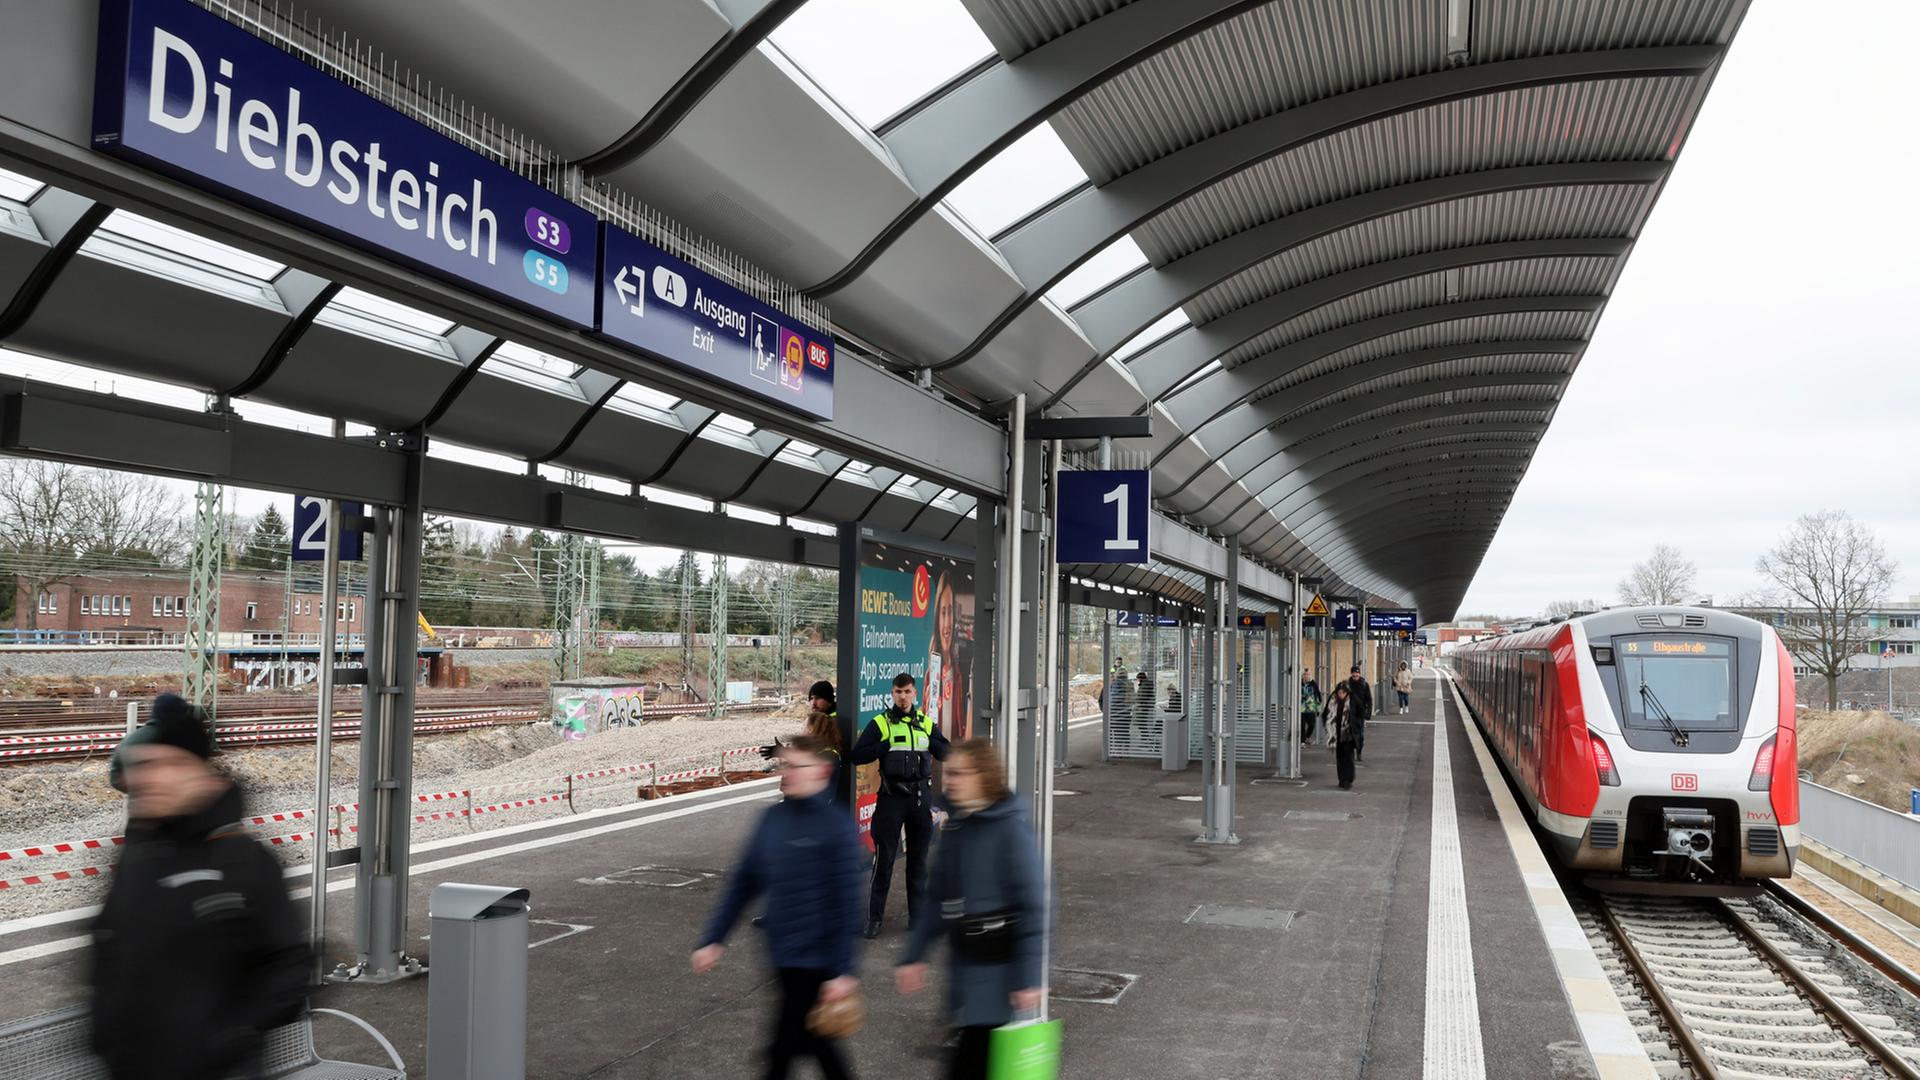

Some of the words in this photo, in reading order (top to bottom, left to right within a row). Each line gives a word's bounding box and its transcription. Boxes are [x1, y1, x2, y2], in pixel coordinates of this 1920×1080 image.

[149, 26, 498, 265] Diebsteich
[665, 274, 675, 300] A
[693, 287, 746, 338] Ausgang
[692, 325, 715, 354] Exit
[811, 345, 826, 366] BUS
[299, 496, 327, 550] 2
[1103, 483, 1139, 550] 1
[861, 589, 887, 615] REWE
[889, 592, 911, 617] Bonus
[1118, 610, 1129, 626] 2
[1346, 612, 1357, 630] 1
[861, 624, 906, 653] Teilnehmen,
[860, 656, 877, 686] App
[879, 662, 909, 680] scannen
[911, 657, 924, 678] und
[860, 688, 883, 713] Euros
[1675, 776, 1694, 788] DB
[859, 802, 876, 821] REW
[1746, 811, 1773, 820] hvv
